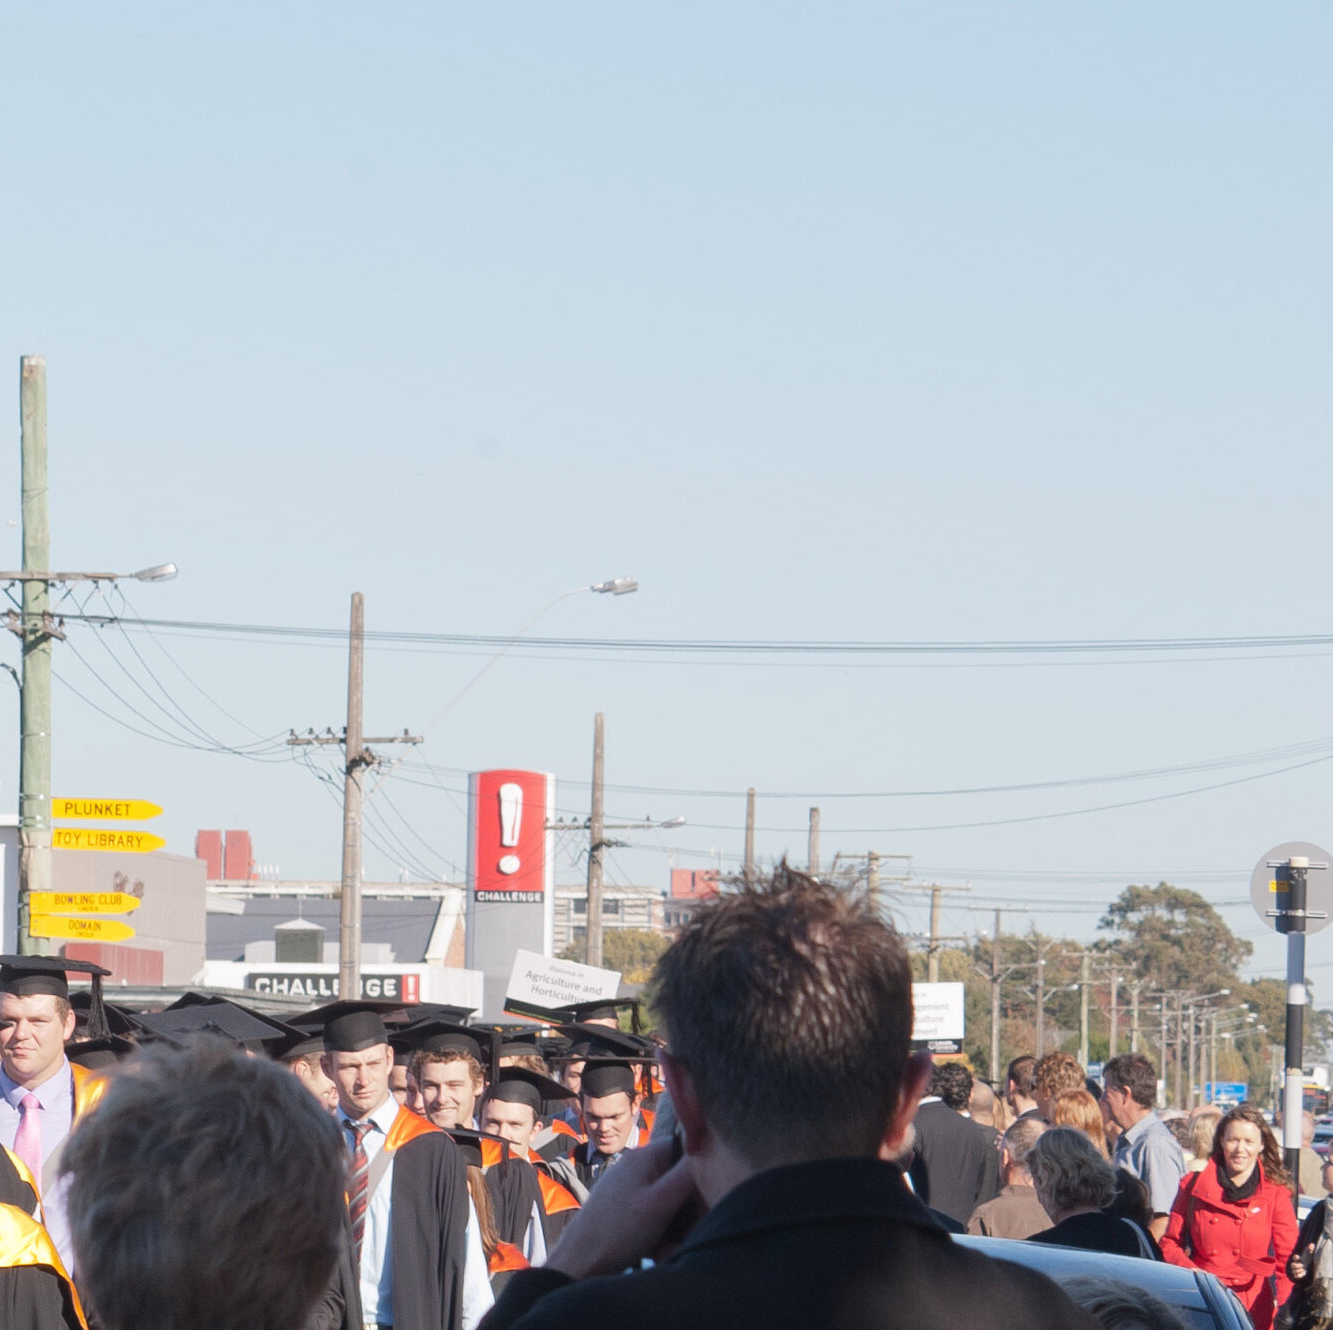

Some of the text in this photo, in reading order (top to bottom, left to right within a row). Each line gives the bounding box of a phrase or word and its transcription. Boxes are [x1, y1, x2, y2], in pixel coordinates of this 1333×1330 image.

[64, 802, 131, 816] PLUNKET
[57, 832, 143, 848] TOY LIBRARY
[54, 894, 122, 905] BOWLING CLUB
[477, 891, 542, 902] CHALLENGE
[69, 920, 101, 931] DOMAIN
[526, 970, 603, 996] Agriculture and
